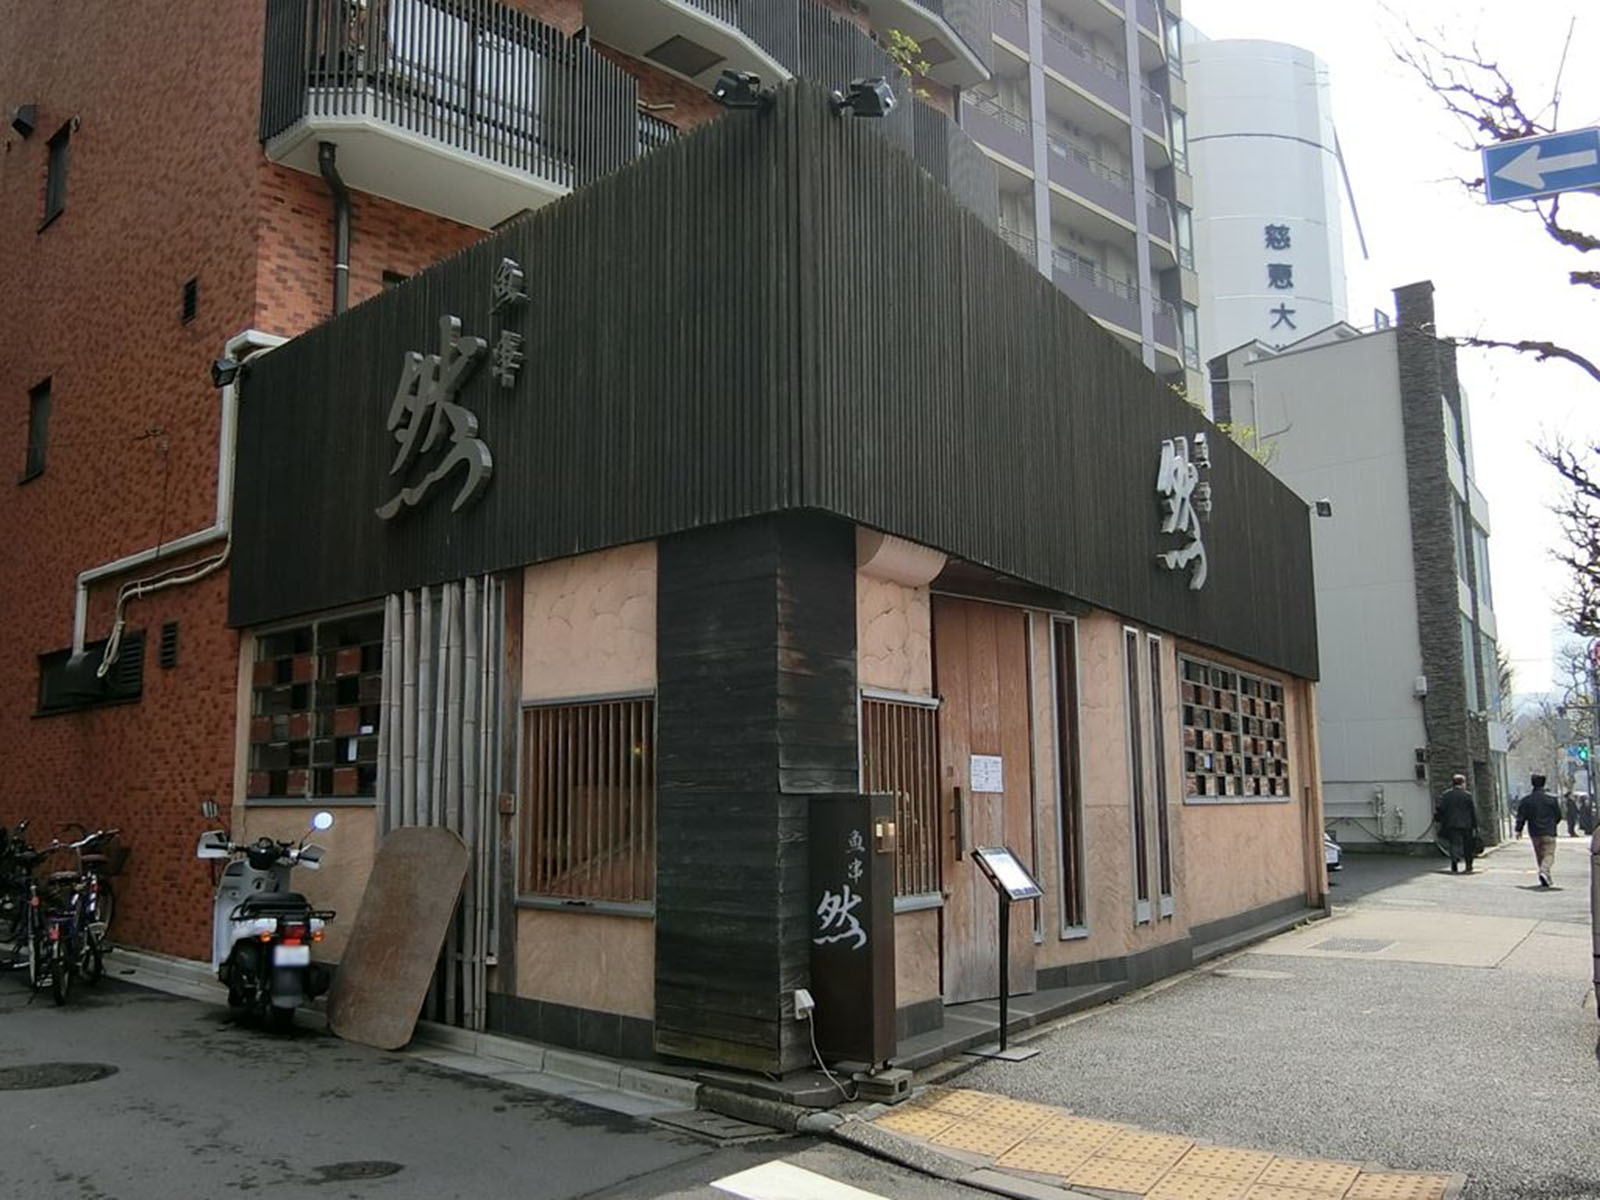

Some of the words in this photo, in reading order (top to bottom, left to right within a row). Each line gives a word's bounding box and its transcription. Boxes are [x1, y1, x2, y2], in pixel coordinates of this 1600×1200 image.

[1264, 223, 1297, 350] 慈恵大
[813, 883, 868, 951] 然
